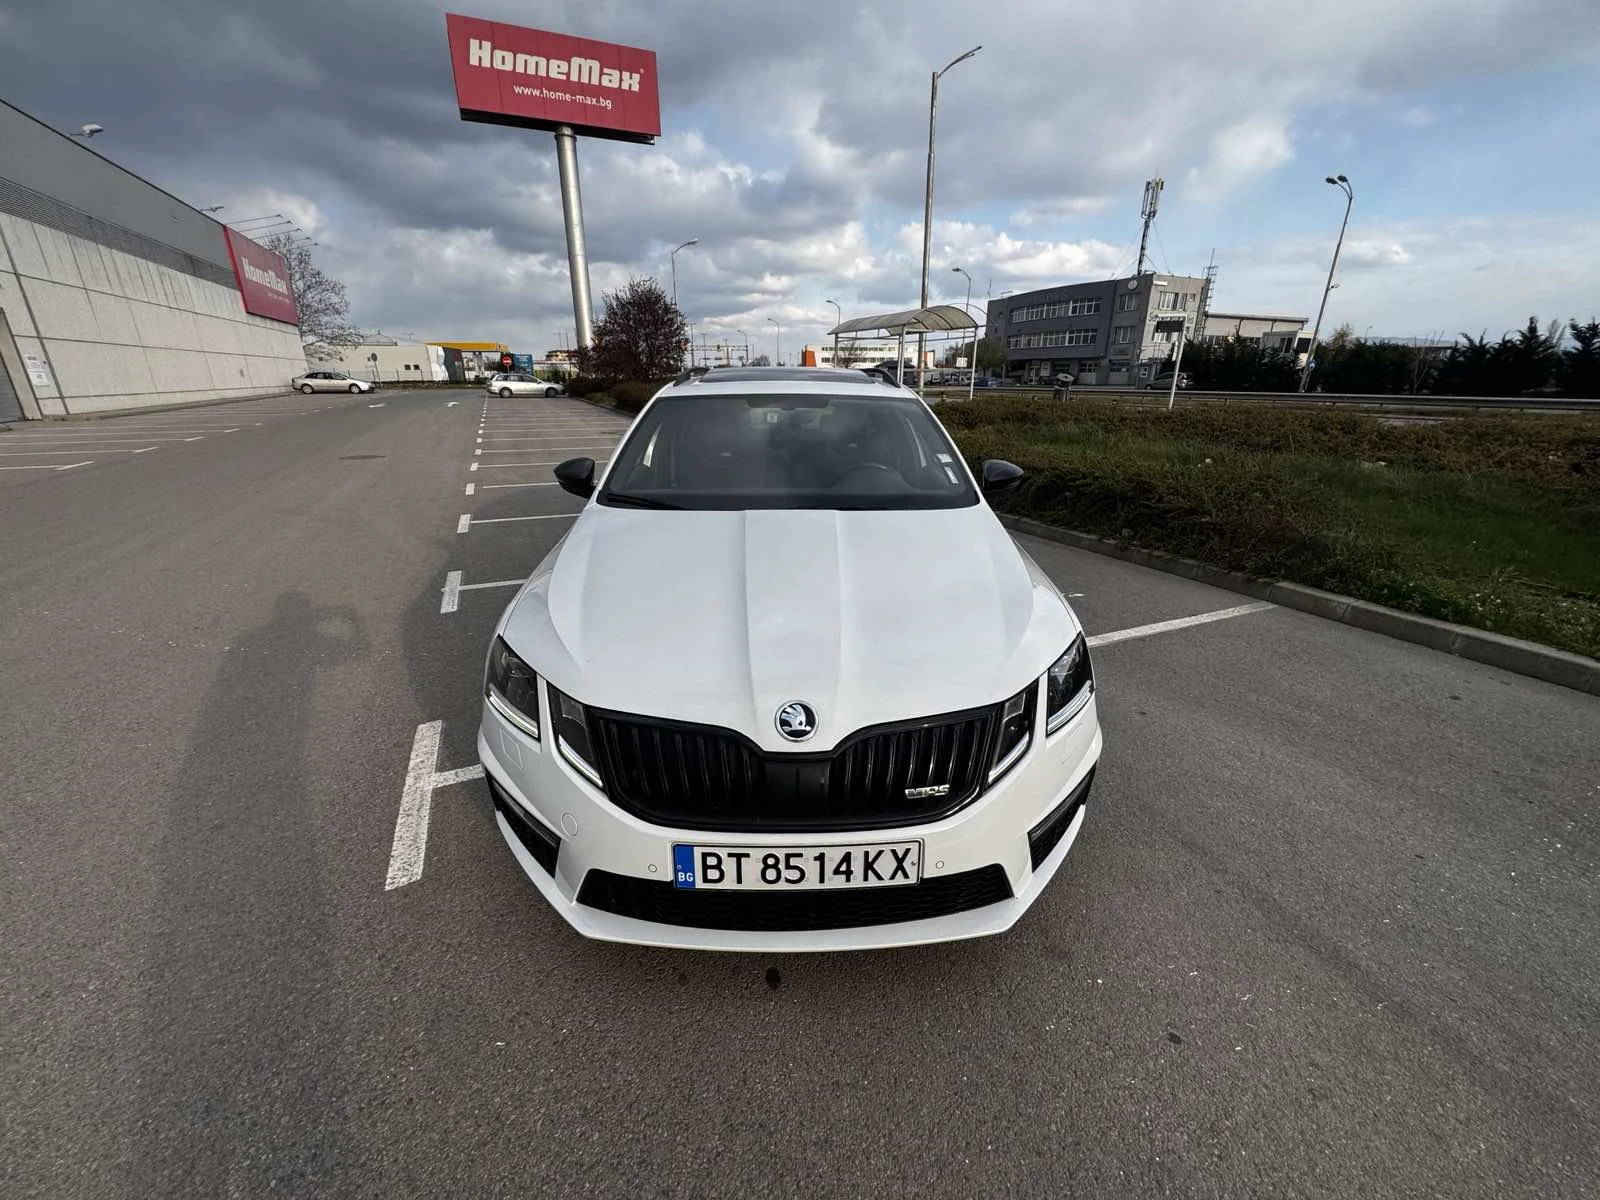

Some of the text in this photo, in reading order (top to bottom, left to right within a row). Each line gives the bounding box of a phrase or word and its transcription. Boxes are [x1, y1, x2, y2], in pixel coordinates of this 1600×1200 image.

[469, 38, 641, 92] HomeMax
[513, 84, 612, 110] www.home-max.bg
[241, 256, 288, 295] HomeMax
[677, 871, 694, 883] BG
[701, 851, 750, 884] BT
